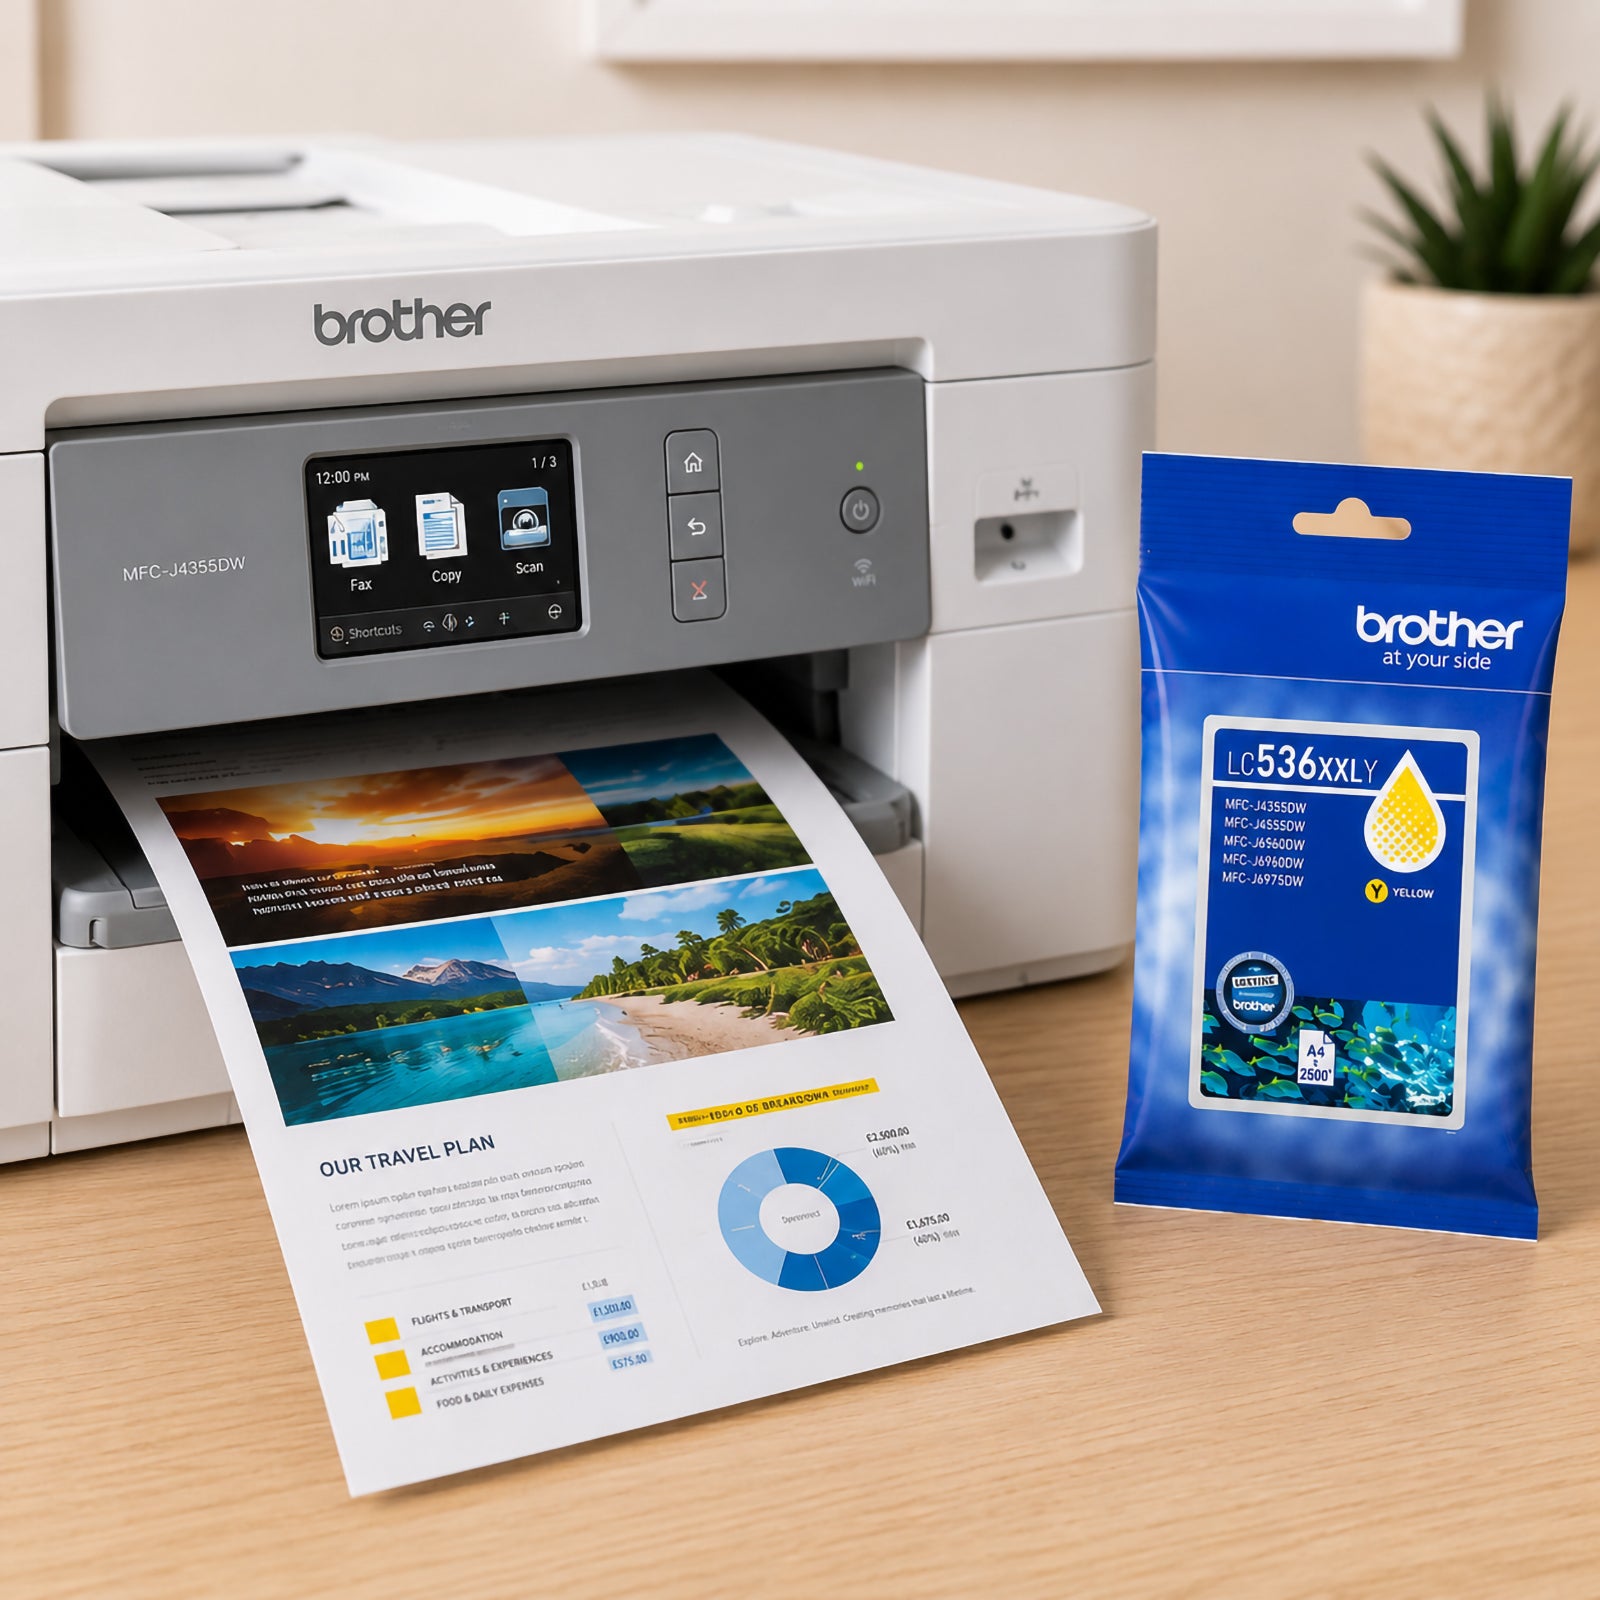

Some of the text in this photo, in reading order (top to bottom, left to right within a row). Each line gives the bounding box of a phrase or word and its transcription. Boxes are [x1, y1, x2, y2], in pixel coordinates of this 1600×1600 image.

[314, 298, 491, 346] brother
[316, 470, 371, 485] 12:00 PM
[122, 555, 246, 581] MFC-J4355DW
[431, 570, 463, 584] Copy
[515, 560, 545, 575] Scan
[350, 578, 373, 592] Fax
[1356, 604, 1524, 651] brother
[1382, 649, 1492, 671] at your side
[1222, 853, 1305, 870] MFC-J6960DW
[1221, 871, 1305, 888] MFC-J6975DW
[1370, 883, 1435, 900] Y YELLOW
[1232, 999, 1276, 1013] brother
[1306, 1044, 1326, 1059] A4
[319, 1134, 496, 1178] OUR TRAVEL PLAN
[411, 1310, 450, 1327] FLIGHTS
[460, 1297, 513, 1316] TRANSPORT
[420, 1330, 504, 1357] ACCOMMODATION
[430, 1366, 481, 1387] ACTIVITIES
[491, 1350, 554, 1372] EXPERIENCES
[436, 1395, 464, 1410] FOOD
[472, 1385, 500, 1402] DAILY
[500, 1376, 545, 1395] EXPENSES
